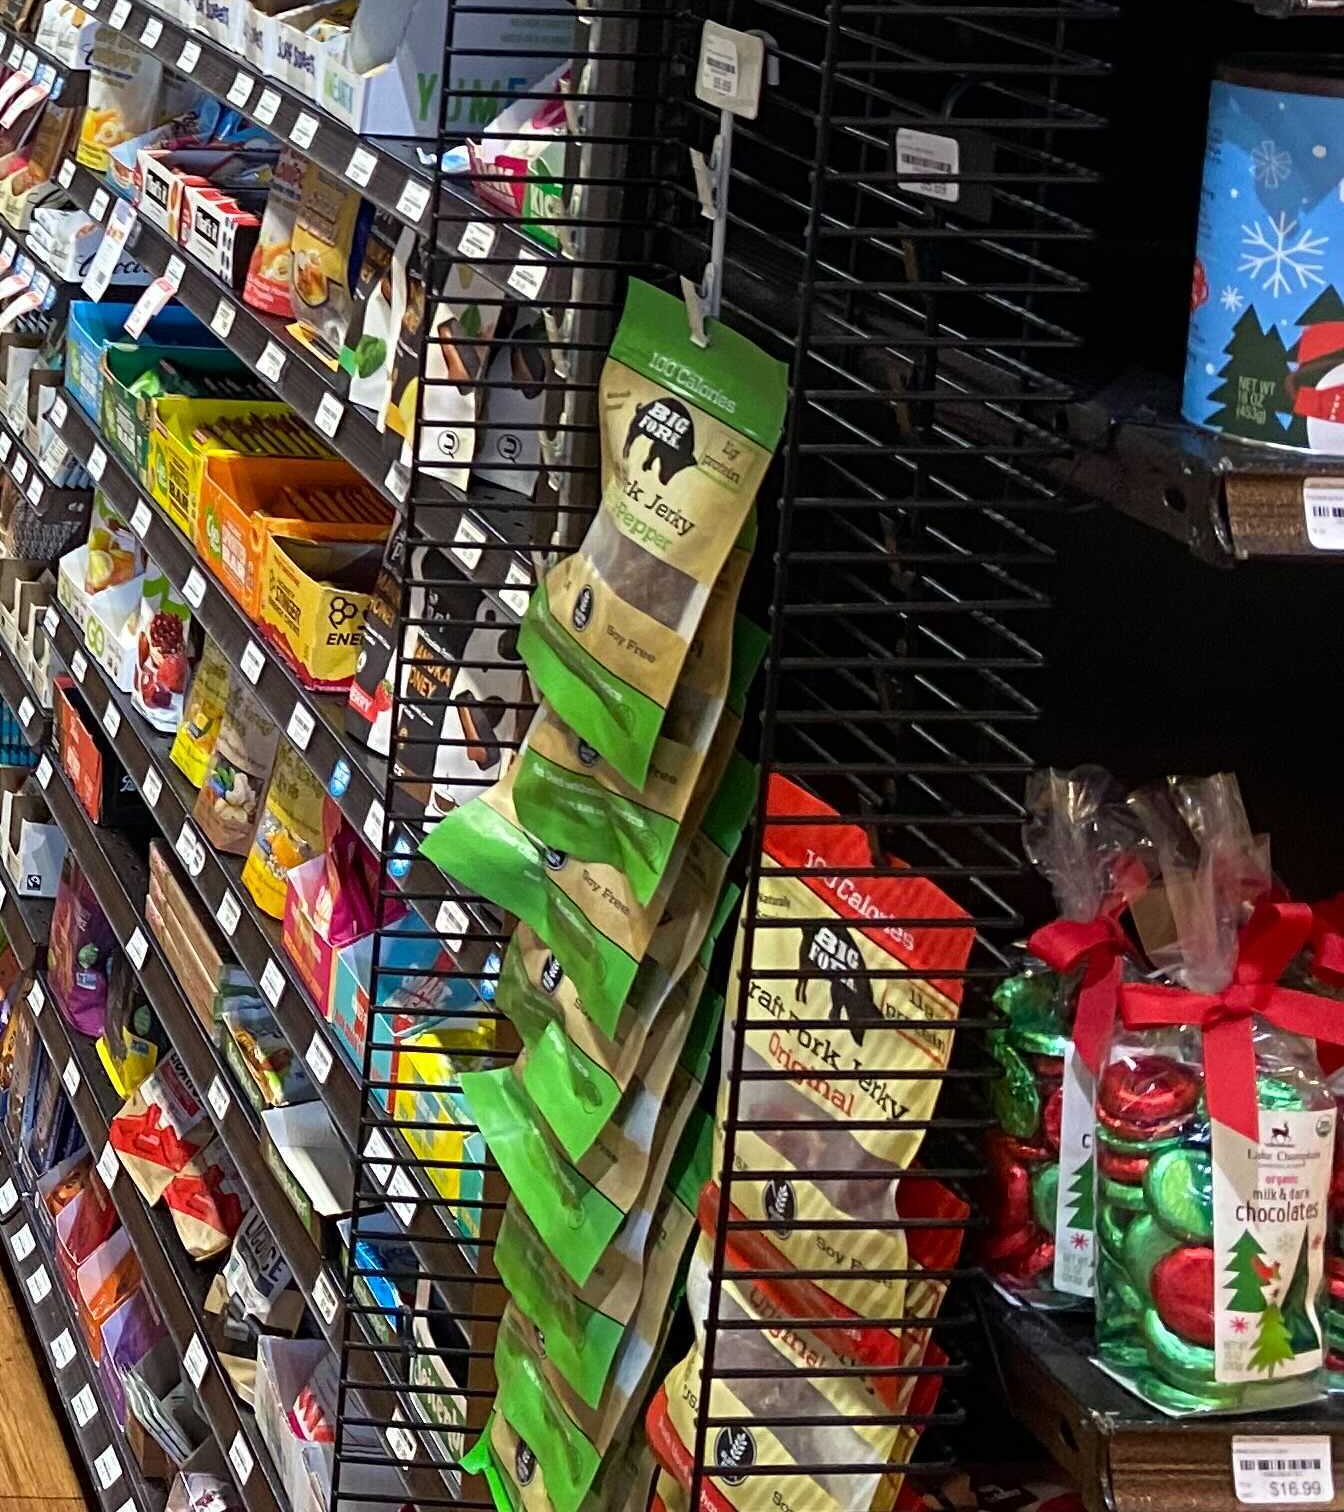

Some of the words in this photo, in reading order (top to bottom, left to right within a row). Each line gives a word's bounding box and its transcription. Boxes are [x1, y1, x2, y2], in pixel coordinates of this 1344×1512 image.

[648, 351, 675, 376] 100
[675, 366, 737, 414] Calories
[638, 416, 682, 451] FORK
[648, 402, 691, 435] BIG
[644, 494, 696, 536] Jerky
[814, 927, 860, 970] BIG
[1253, 1186, 1278, 1200] milk
[1279, 1188, 1287, 1201] &
[1289, 1187, 1310, 1200] dark
[1236, 1199, 1319, 1224] chocolates
